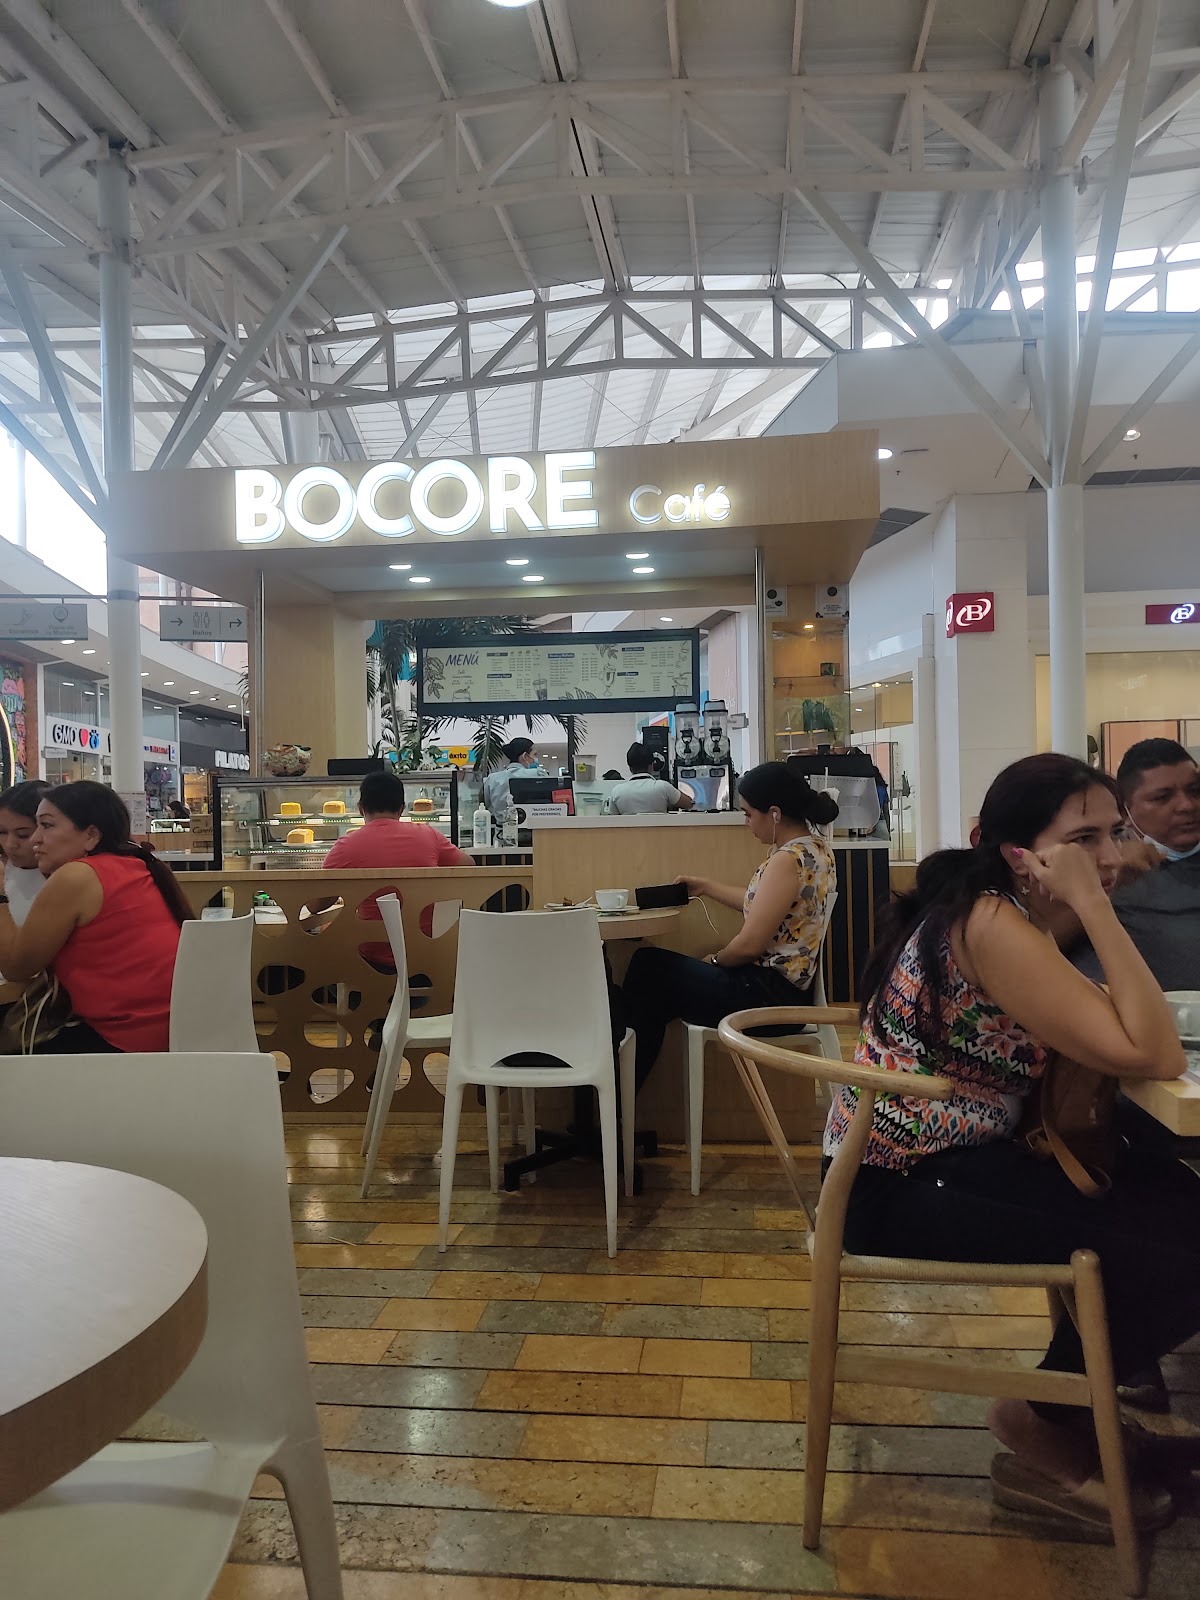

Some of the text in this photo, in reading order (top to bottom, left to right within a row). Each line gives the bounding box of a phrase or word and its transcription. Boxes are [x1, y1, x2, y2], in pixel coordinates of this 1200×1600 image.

[234, 451, 732, 544] BOCORE Café
[445, 651, 480, 667] MENÚ
[52, 723, 77, 746] GMO
[449, 752, 467, 760] éxito
